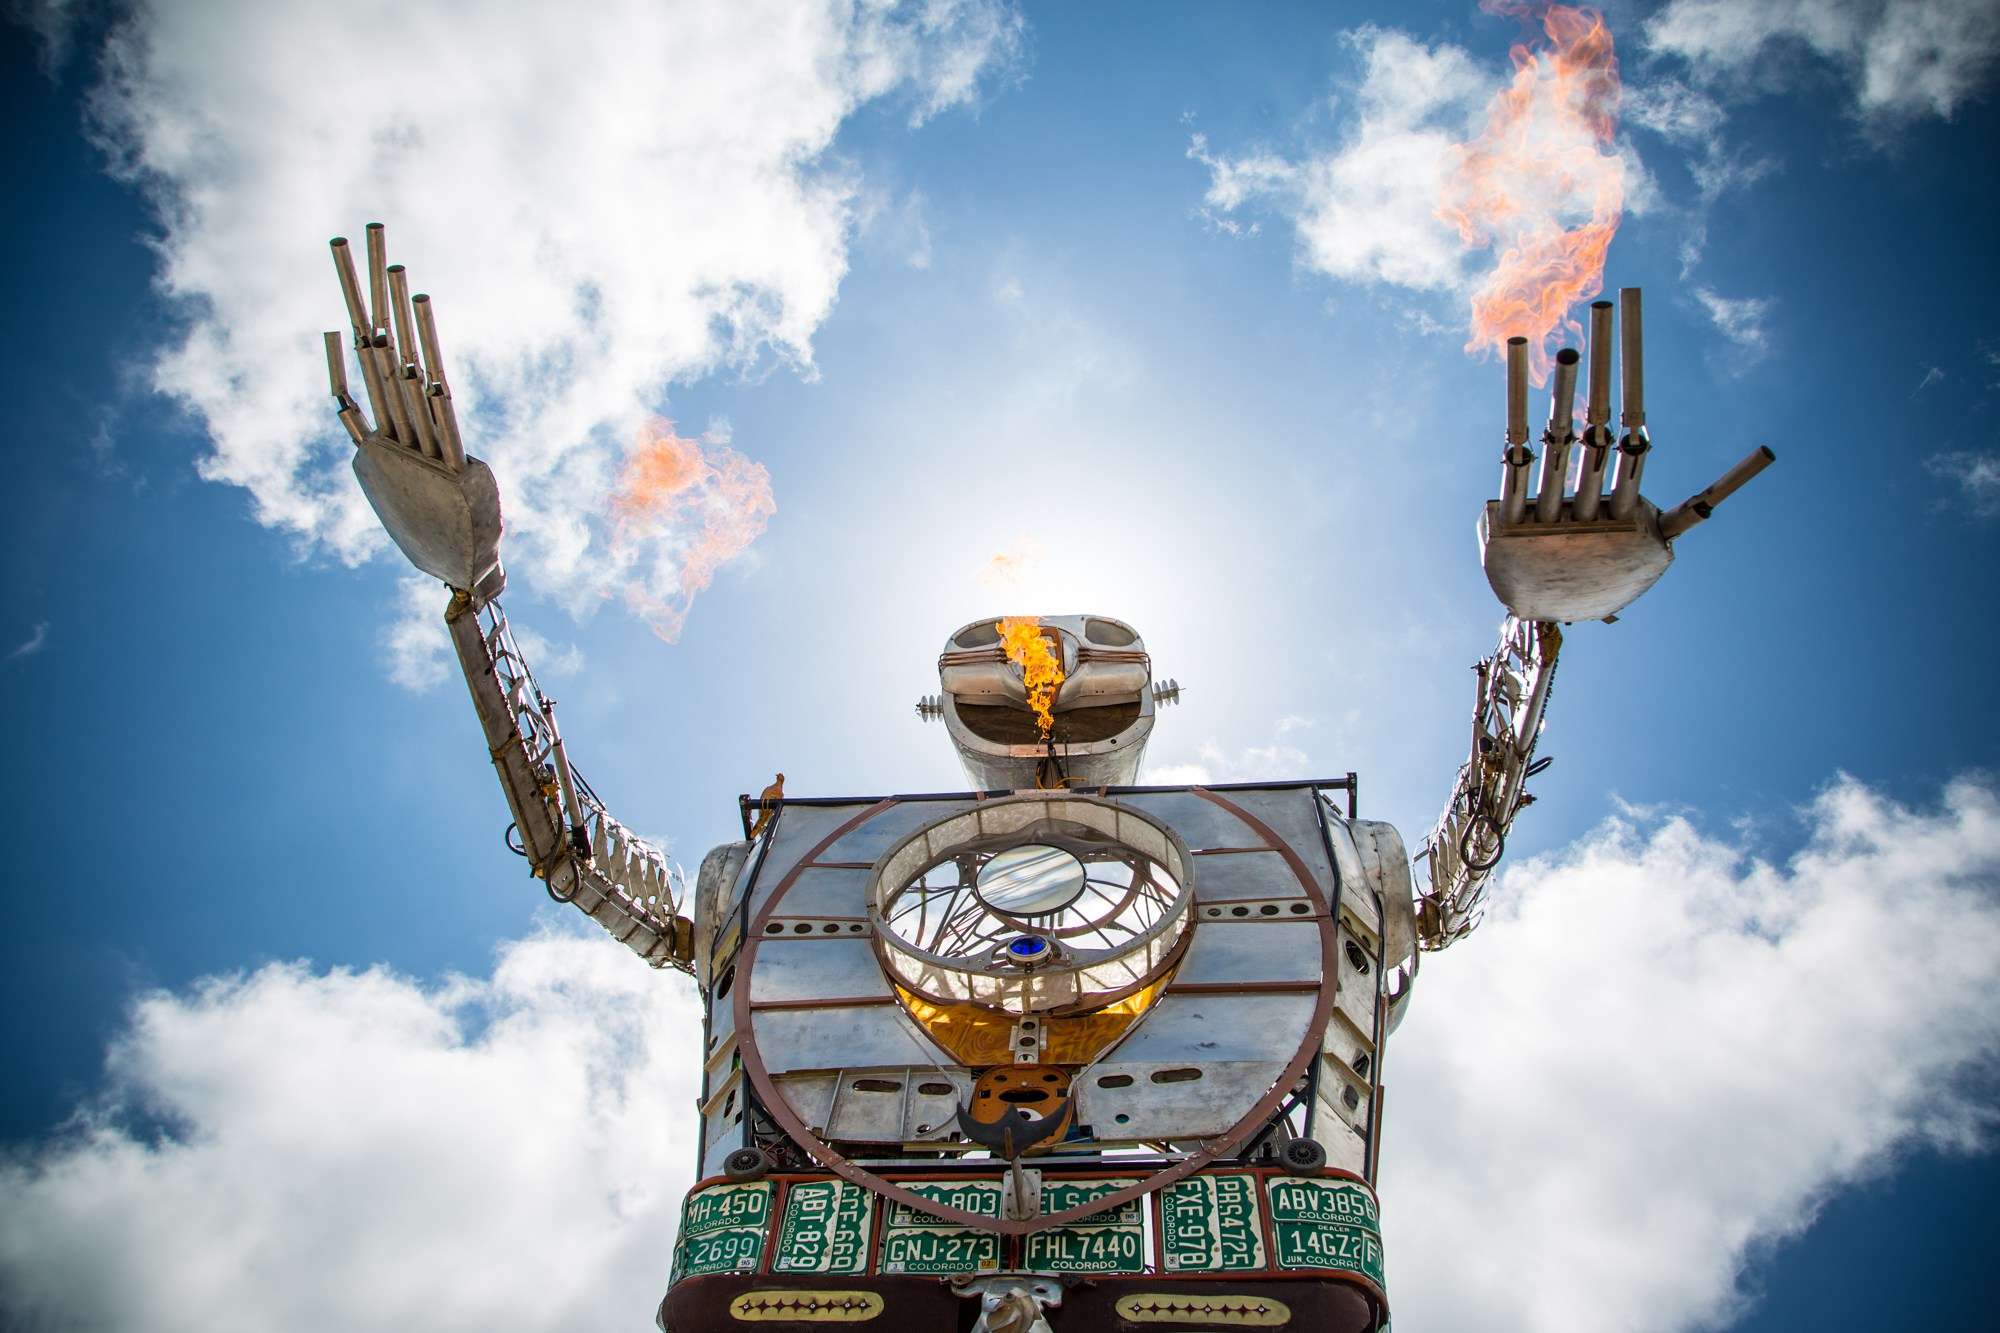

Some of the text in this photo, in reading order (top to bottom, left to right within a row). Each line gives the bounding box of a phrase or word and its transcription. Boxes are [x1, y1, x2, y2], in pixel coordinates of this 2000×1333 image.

[1279, 1188, 1376, 1221] ABV3856
[685, 1216, 741, 1235] COLORADO
[1165, 1196, 1177, 1250] COLORADO
[1298, 1211, 1362, 1224] COLORADO
[781, 1203, 800, 1253] COLORADO
[1317, 1224, 1350, 1232] DEALER
[908, 1262, 974, 1271] COLORADO
[1051, 1260, 1117, 1270] COLORADO
